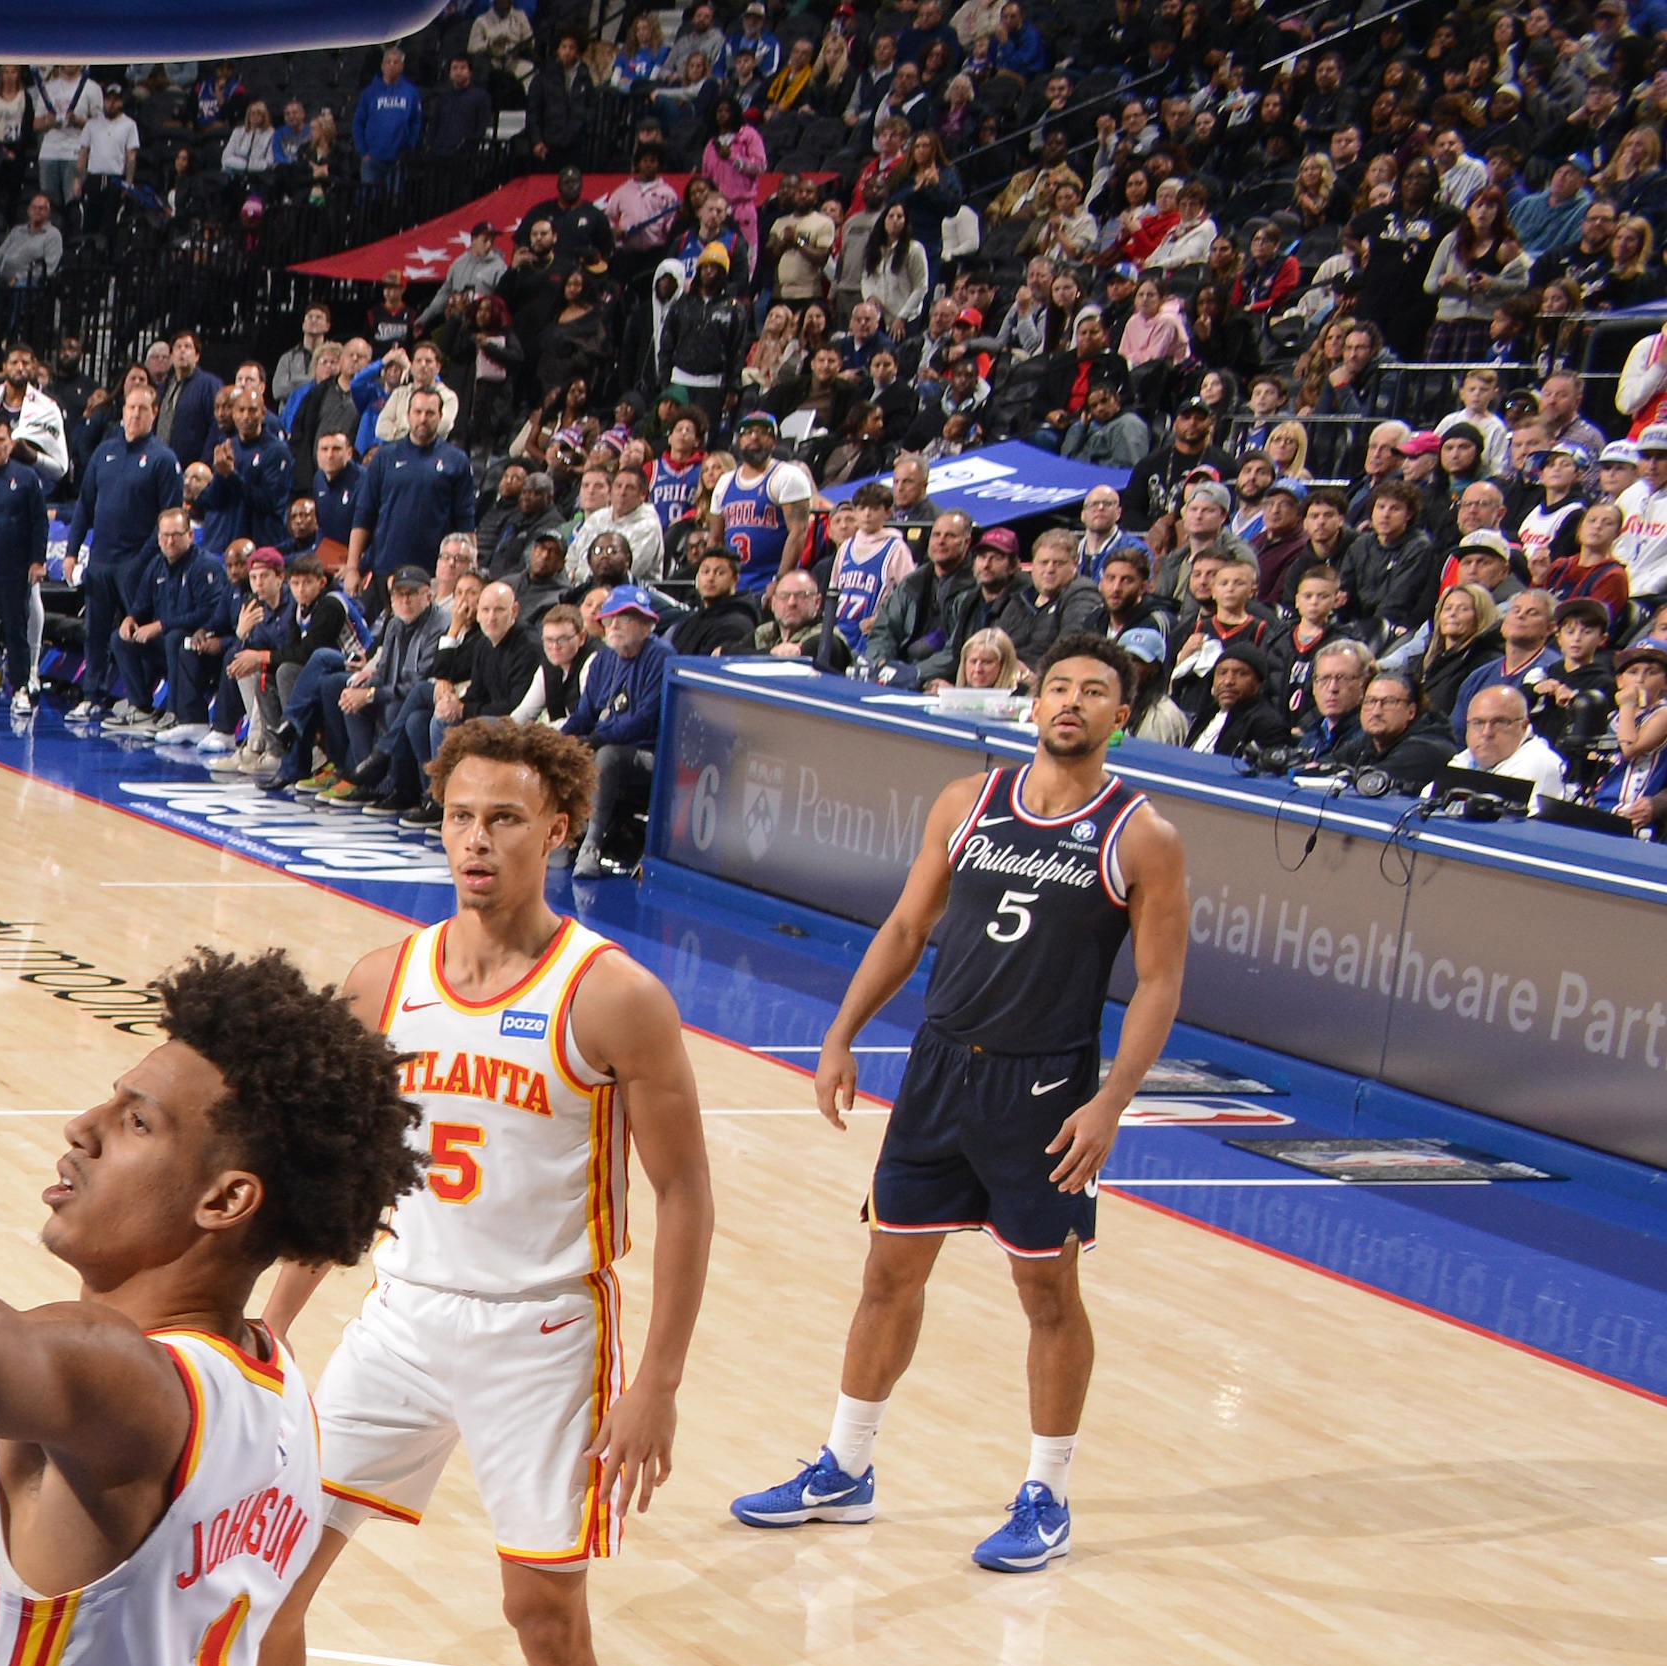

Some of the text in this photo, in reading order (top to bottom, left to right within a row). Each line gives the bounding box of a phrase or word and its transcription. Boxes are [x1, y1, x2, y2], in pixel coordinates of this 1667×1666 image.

[731, 534, 751, 563] 3
[792, 766, 876, 857] Penn
[956, 833, 1098, 890] Philadelphia
[986, 889, 1040, 943] 5
[1272, 899, 1537, 1033] Healthcare
[503, 1014, 546, 1032] paze
[397, 1050, 554, 1119] TLANTA
[426, 1120, 487, 1205] 5
